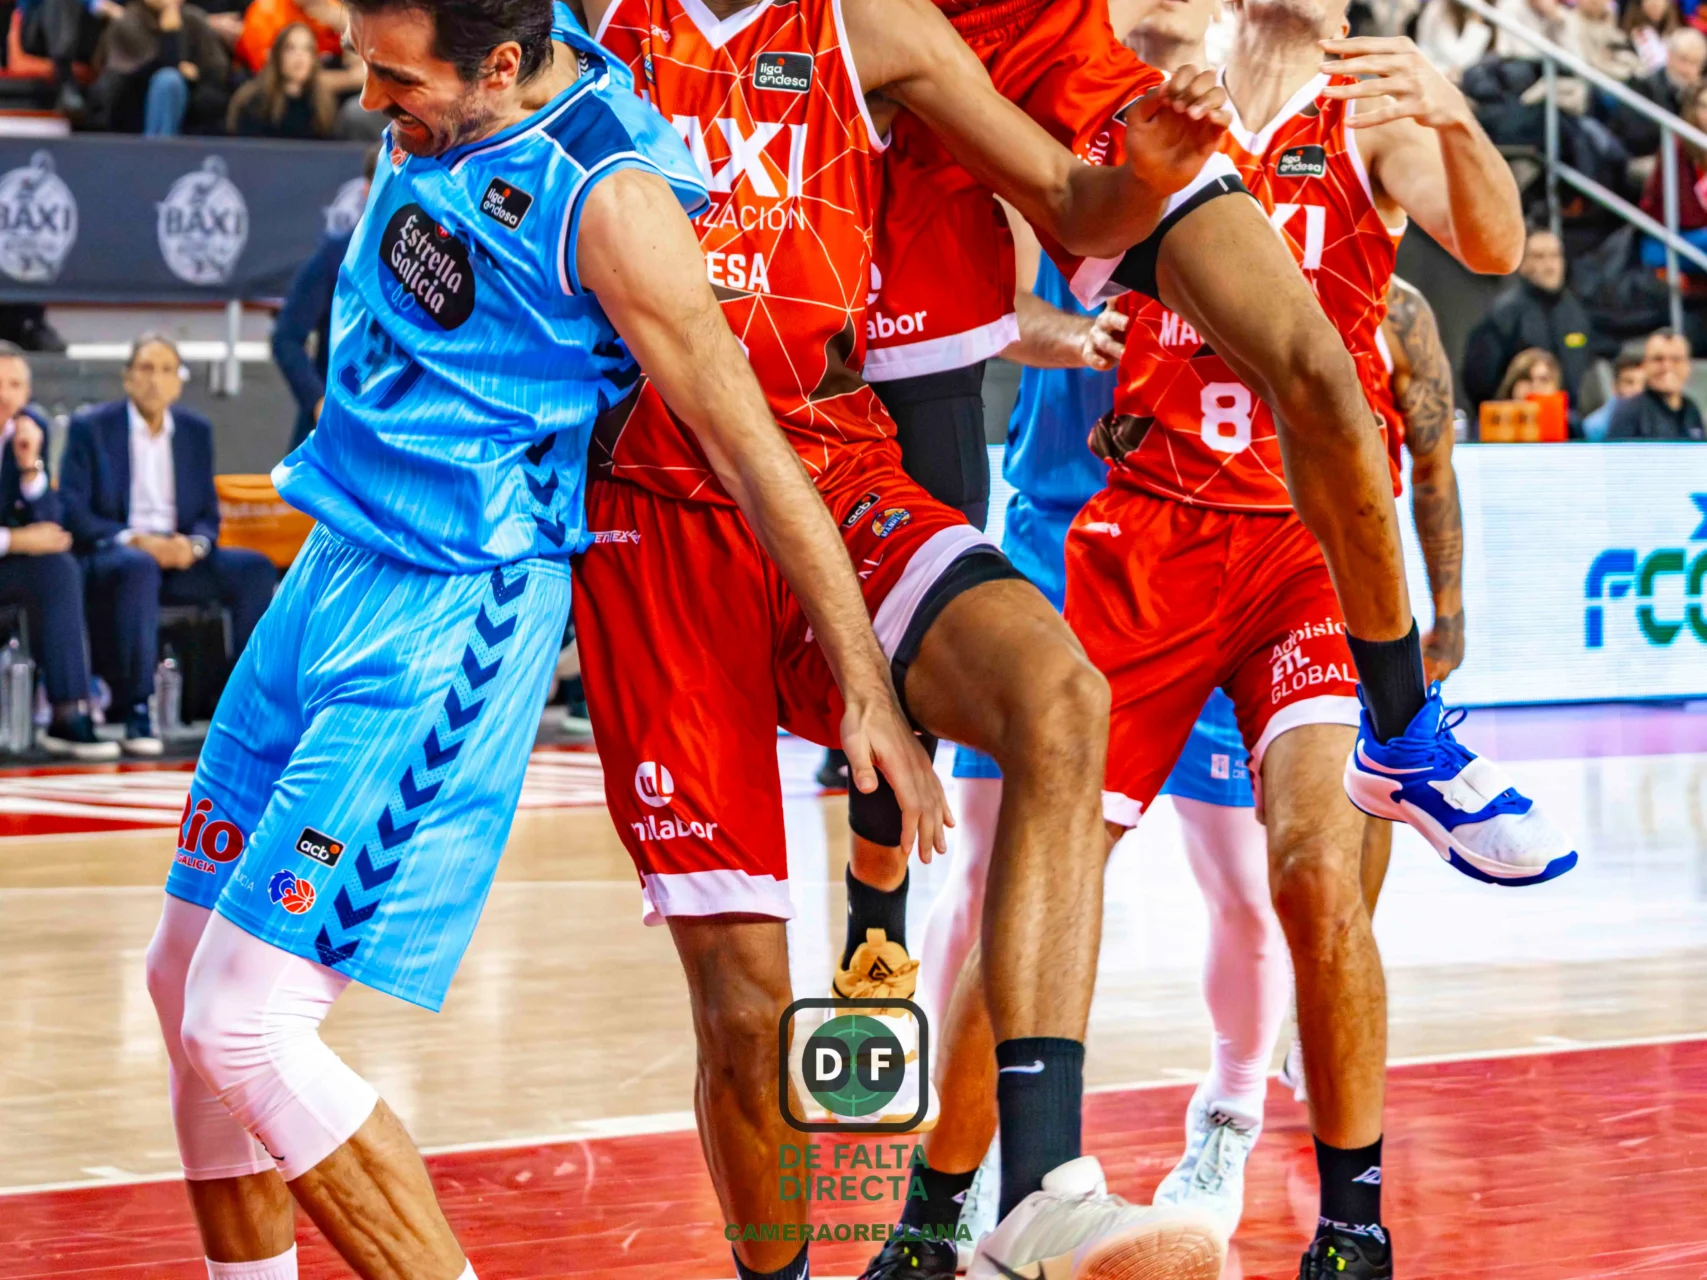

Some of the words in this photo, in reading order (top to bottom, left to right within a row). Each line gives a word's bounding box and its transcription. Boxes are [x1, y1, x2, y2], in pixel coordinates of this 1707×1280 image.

[759, 74, 808, 88] endesa
[760, 63, 783, 76] liga
[671, 114, 809, 198] AXI
[1280, 162, 1322, 173] endesa
[487, 187, 506, 205] liga
[166, 206, 245, 235] BAXI
[483, 201, 518, 227] endesa
[694, 202, 806, 231] IZACIÓN
[399, 213, 463, 295] Estrella
[390, 239, 446, 314] Galicia
[867, 310, 927, 340] abor
[1200, 381, 1252, 454] 8
[847, 501, 872, 524] acb
[1271, 645, 1310, 686] ETL
[1271, 663, 1360, 705] GLOBAL
[177, 853, 217, 875] GALICIA
[300, 839, 330, 861] acb
